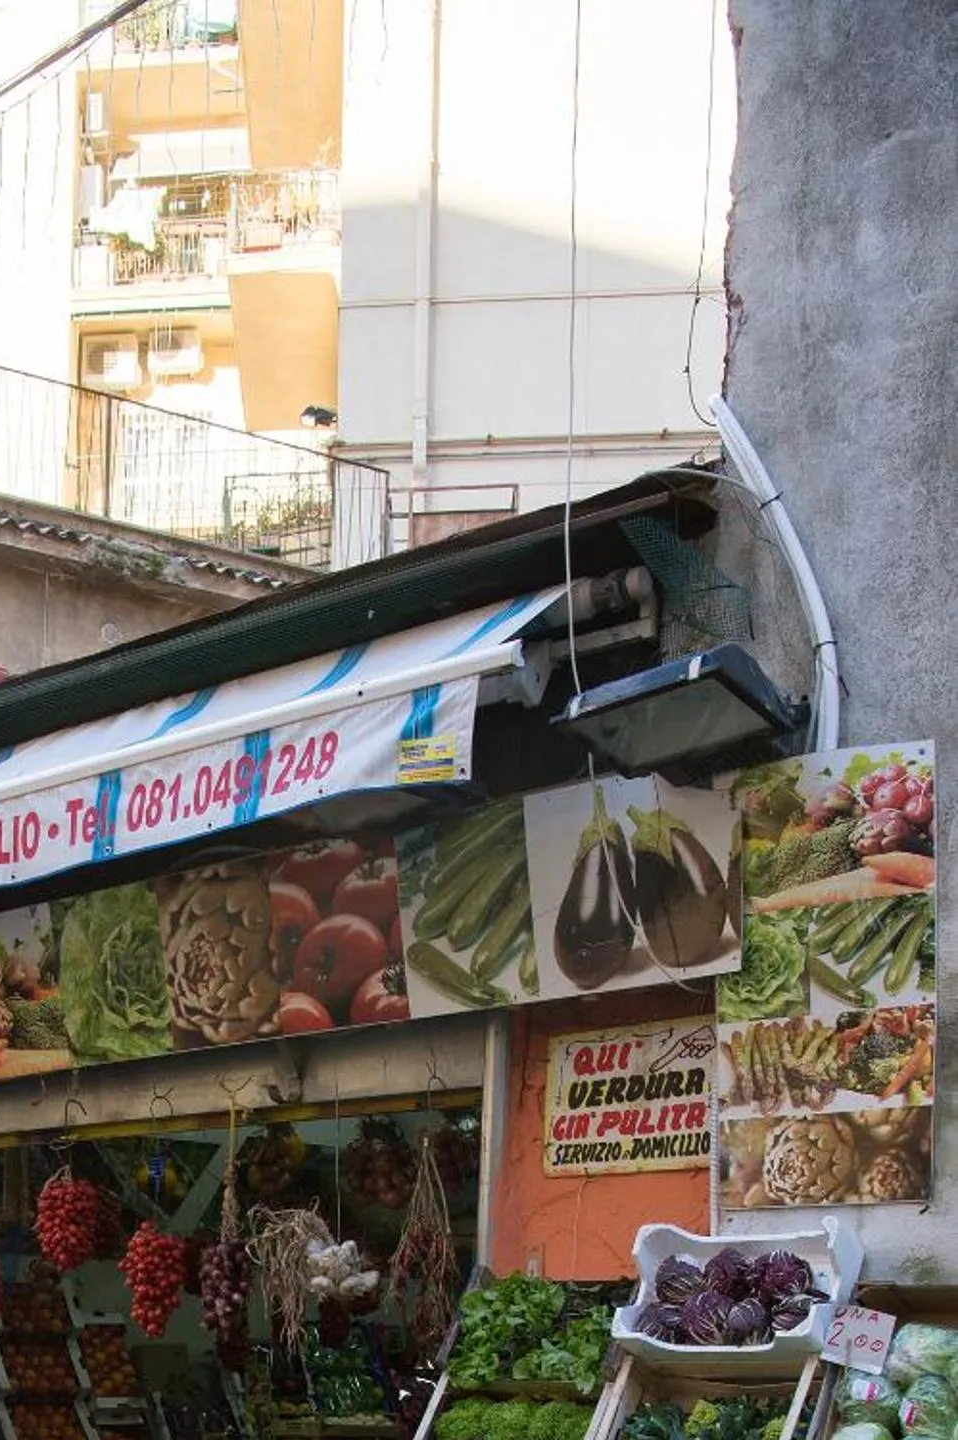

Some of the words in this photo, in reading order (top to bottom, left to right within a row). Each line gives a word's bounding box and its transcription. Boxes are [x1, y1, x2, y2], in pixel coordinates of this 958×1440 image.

[66, 792, 115, 846] Tel.
[126, 731, 338, 832] 081.0491248
[568, 1067, 705, 1110] VERDURA
[597, 1101, 706, 1137] PULITA
[553, 1141, 622, 1165] SERVIZIO
[630, 1130, 711, 1160] DOMICILIO
